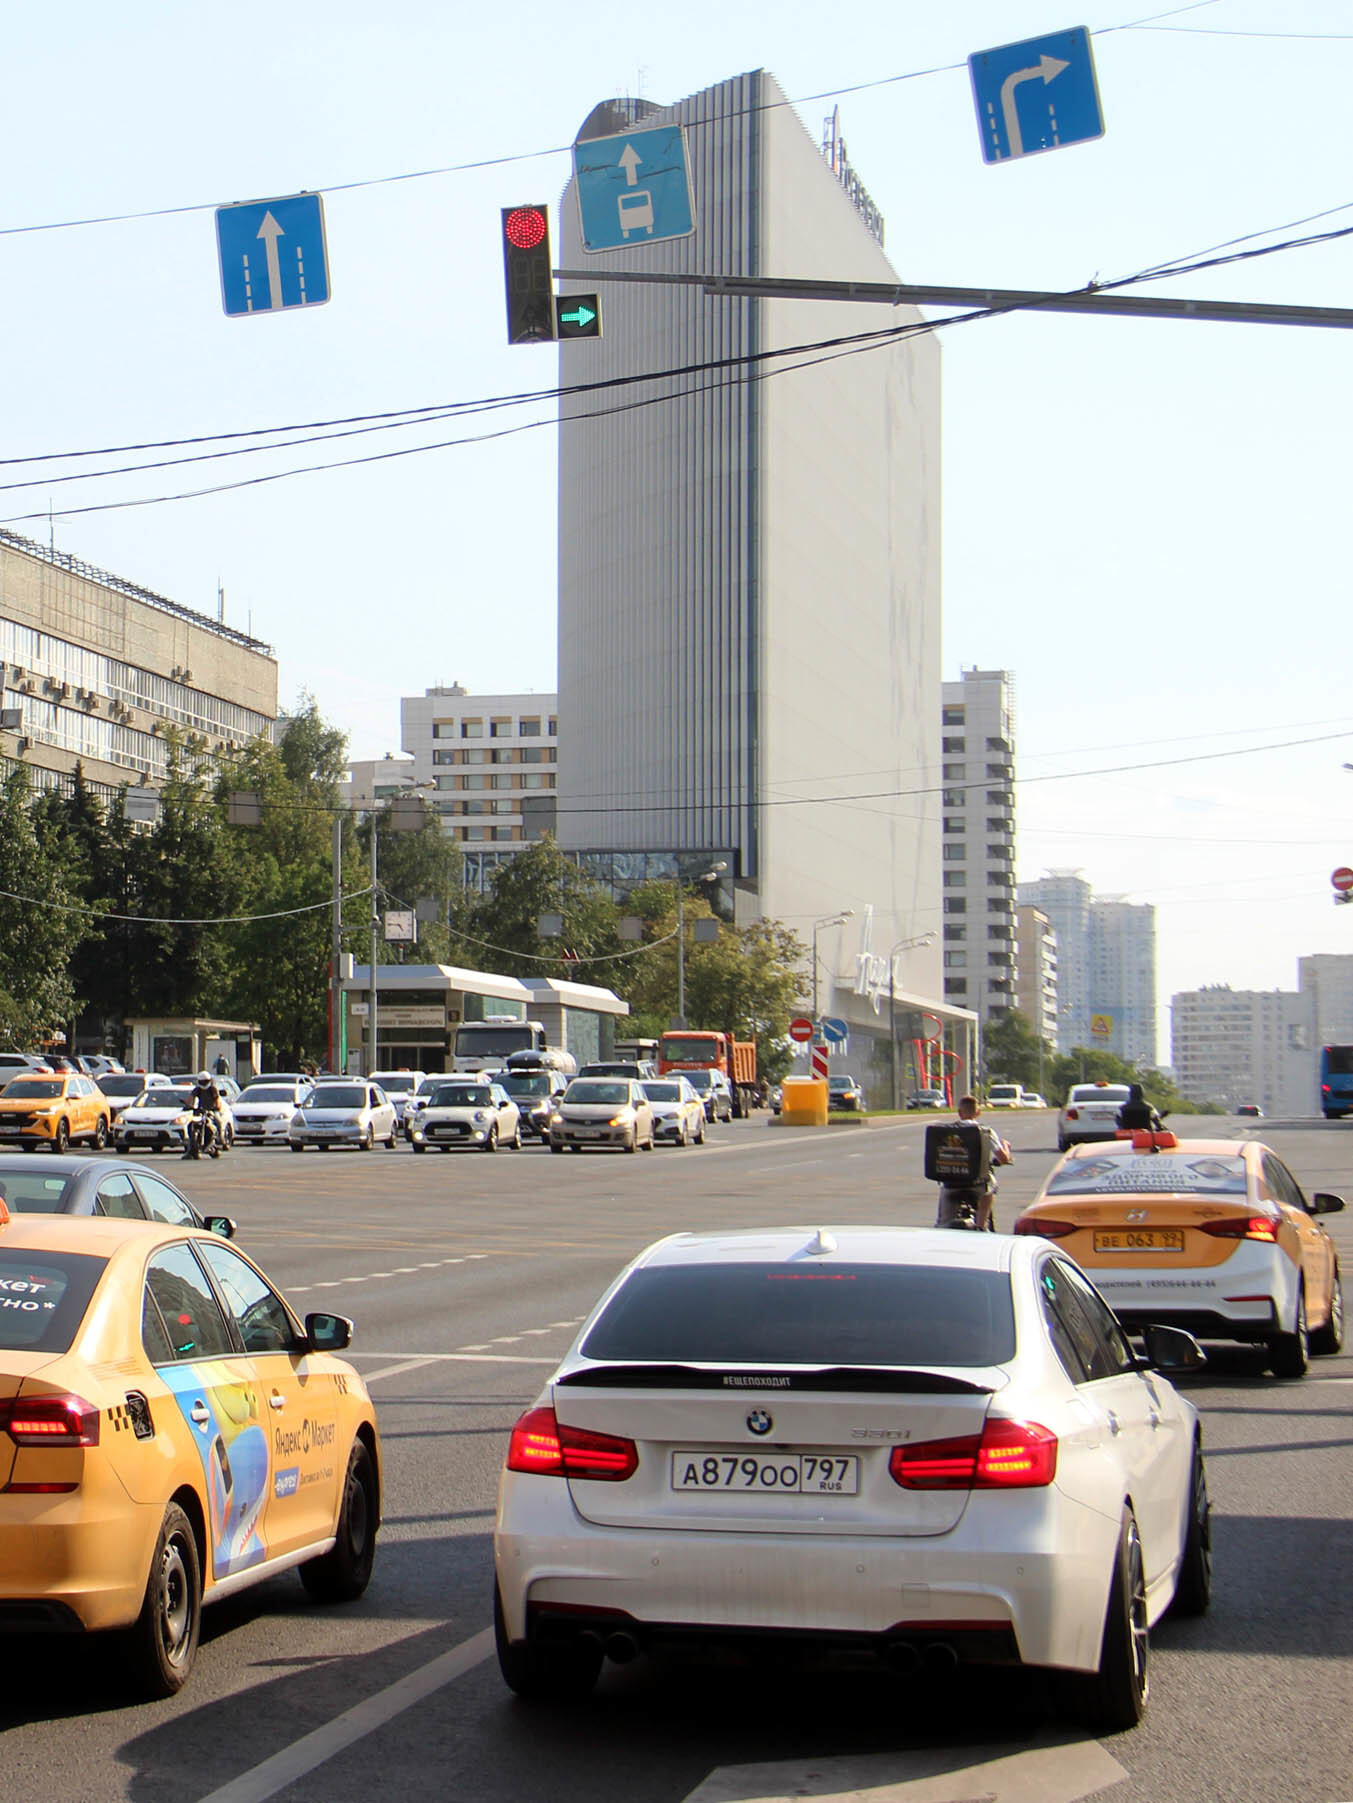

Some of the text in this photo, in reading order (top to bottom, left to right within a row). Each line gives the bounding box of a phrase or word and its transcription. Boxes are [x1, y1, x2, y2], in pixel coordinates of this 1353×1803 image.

[1126, 1233, 1154, 1247] 063
[275, 1420, 335, 1456] Яндекс Маркет
[804, 1458, 849, 1481] 797
[820, 1482, 842, 1491] RUS
